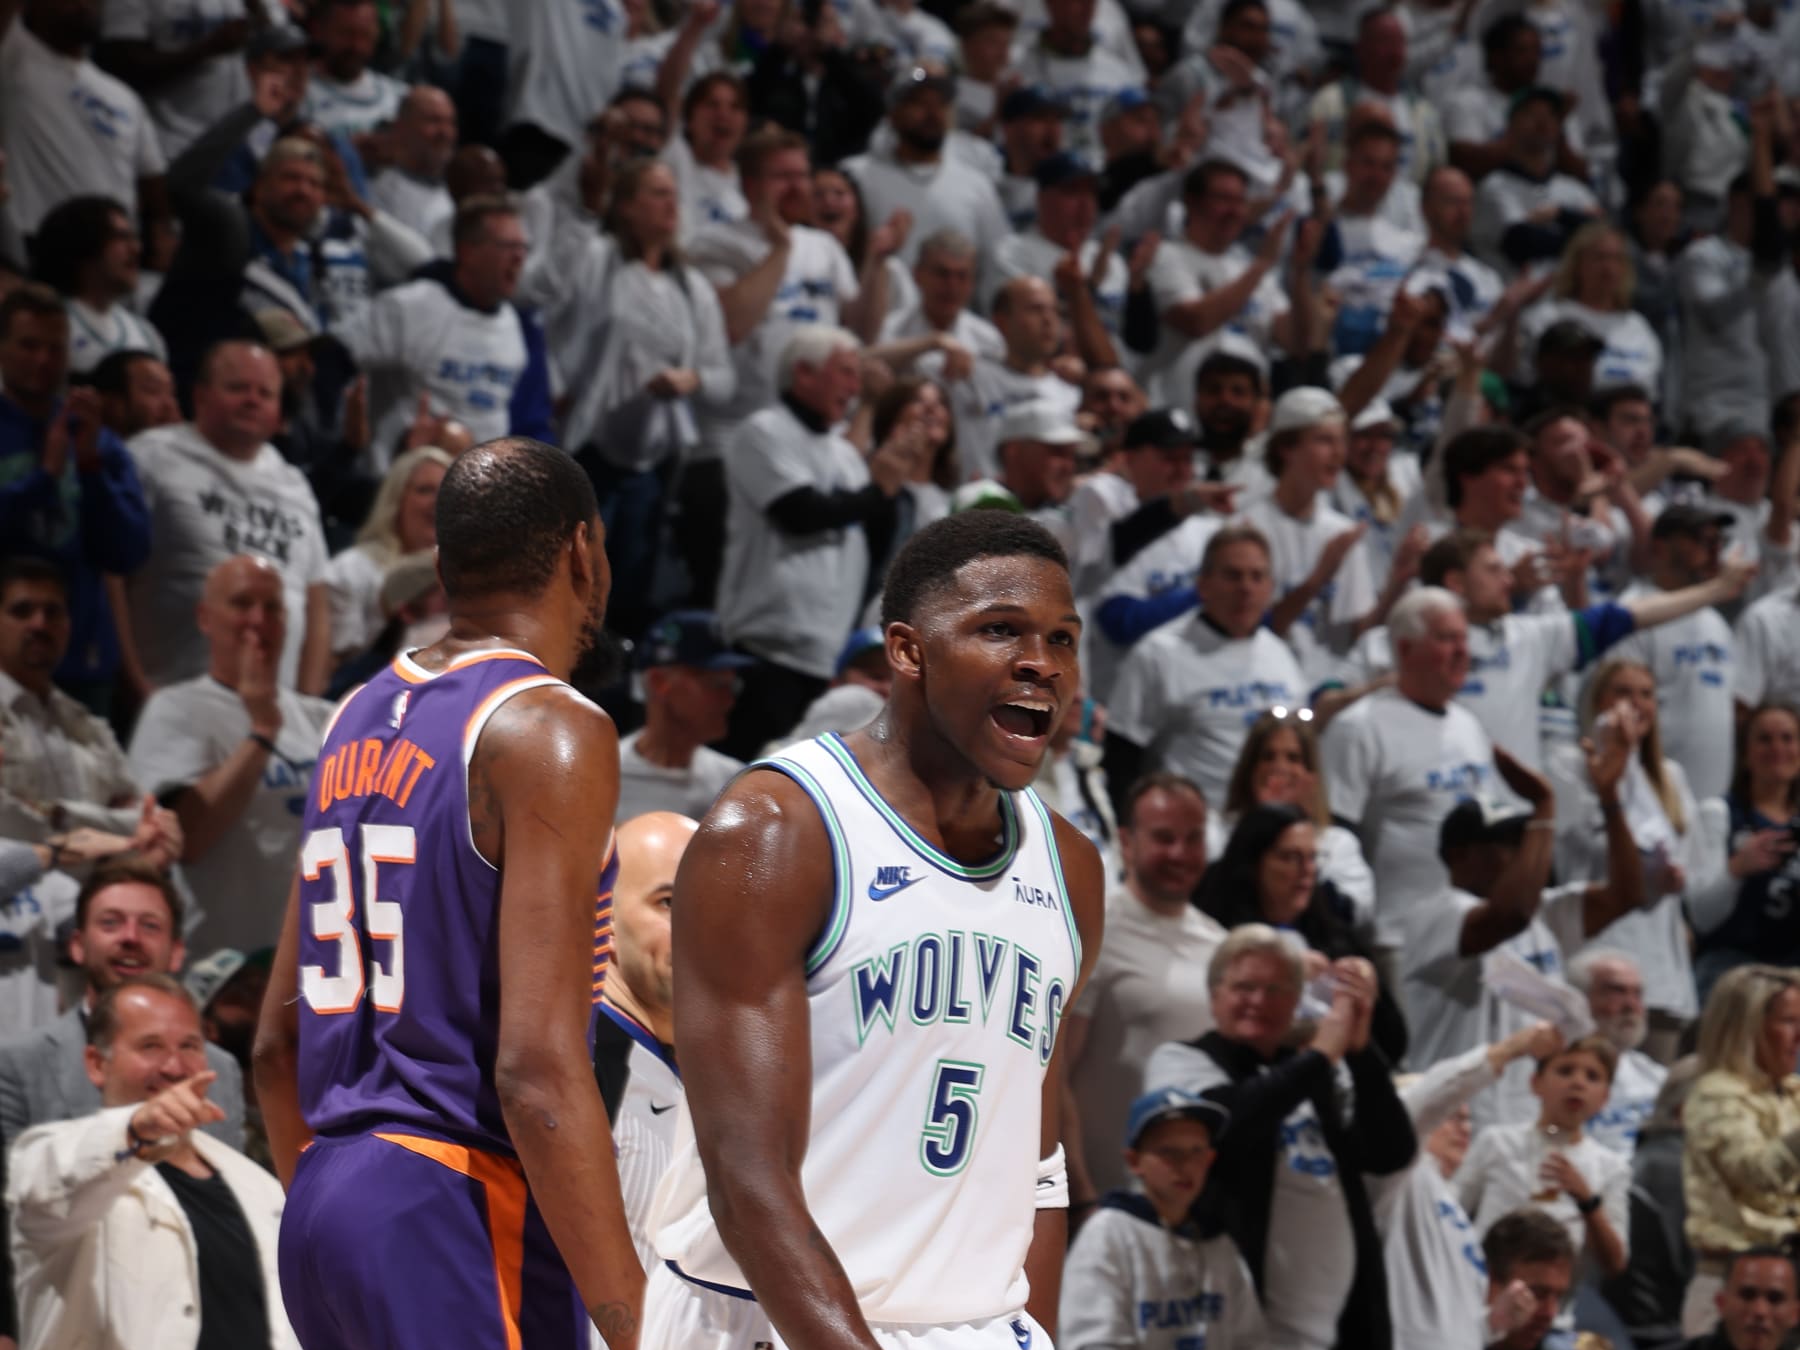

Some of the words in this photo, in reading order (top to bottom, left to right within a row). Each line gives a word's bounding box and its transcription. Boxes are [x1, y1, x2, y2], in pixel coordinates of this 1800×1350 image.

[318, 737, 436, 813] DURANT
[299, 823, 416, 1015] 35
[876, 865, 912, 886] NIKE
[851, 929, 1067, 1068] WOLVES
[919, 1058, 986, 1178] 5
